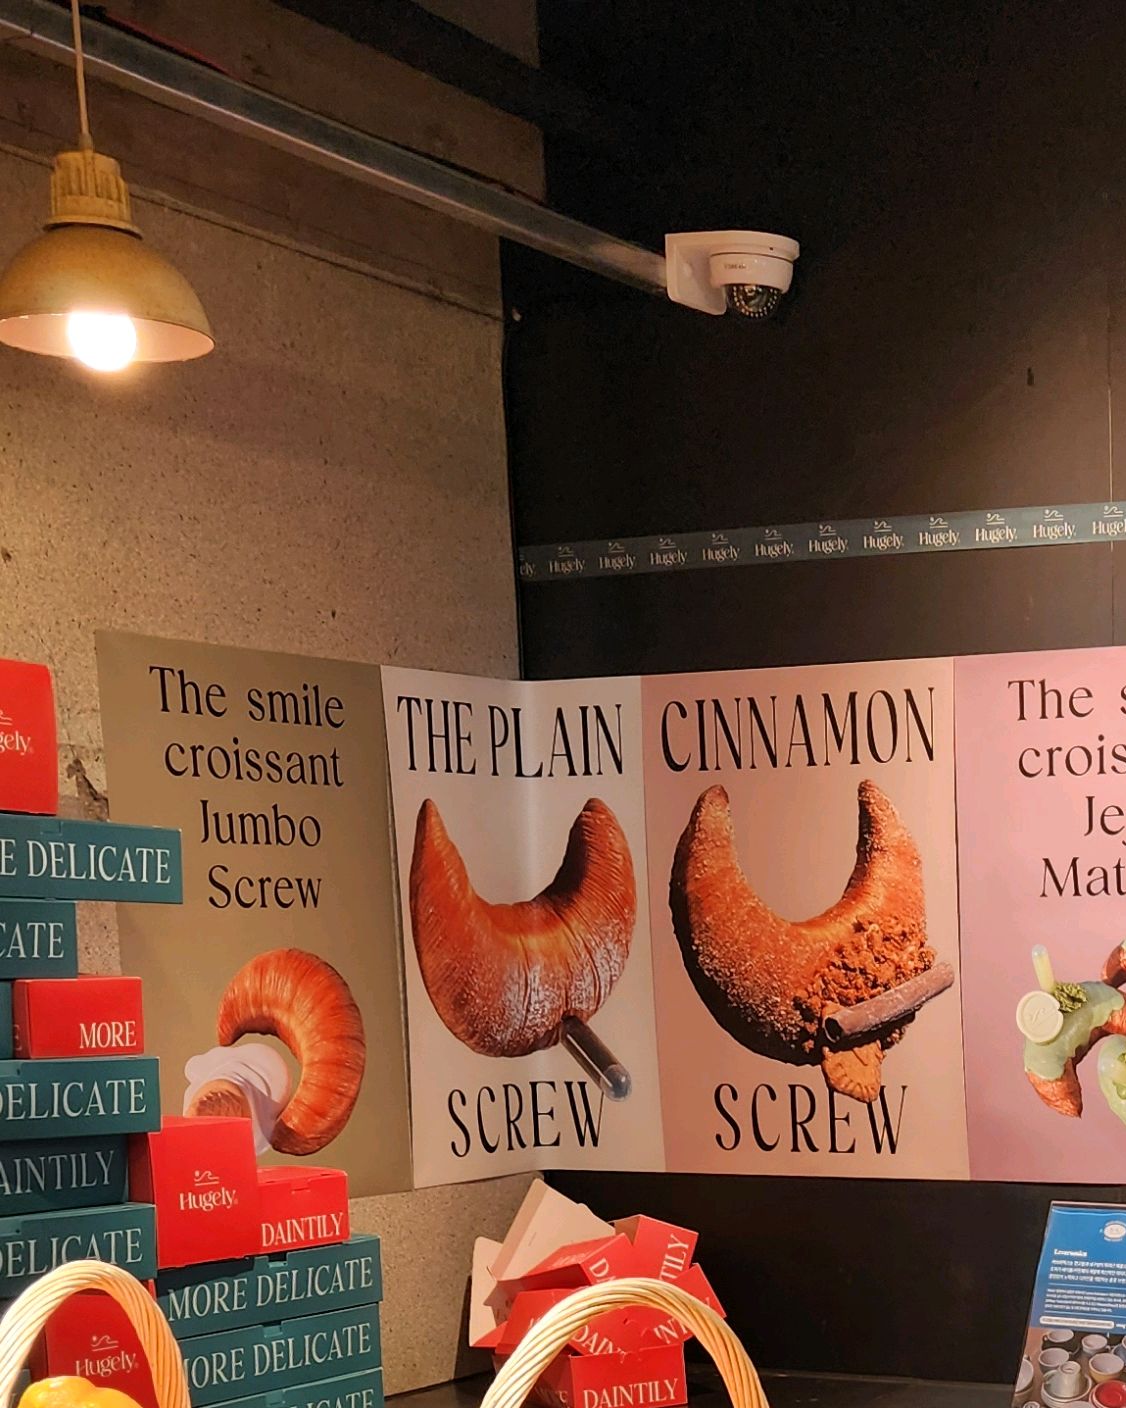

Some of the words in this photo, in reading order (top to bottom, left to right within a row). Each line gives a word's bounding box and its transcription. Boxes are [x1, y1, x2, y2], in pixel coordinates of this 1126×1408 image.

[599, 555, 636, 571] Hugely
[650, 550, 687, 568] Hugely
[702, 546, 740, 562] Hugely
[755, 542, 793, 558] Hugely
[809, 538, 848, 554] Hugely
[863, 534, 903, 550] Hugely
[919, 531, 960, 547] Hugely
[975, 526, 1018, 543] Hugely
[1032, 522, 1075, 540] Hugely
[149, 665, 227, 719] The
[247, 683, 345, 729] smile
[1007, 677, 1094, 721] The
[398, 696, 476, 775] THE
[490, 703, 623, 778] PLAIN
[660, 687, 935, 773] CINNAMON
[165, 738, 345, 787] croissant
[200, 800, 321, 848] Jumbo
[27, 840, 171, 884] DELICATE
[208, 865, 321, 908] Screw
[80, 1021, 136, 1048] MORE
[0, 1079, 146, 1120] ELICATE
[448, 1080, 604, 1157] SCREW
[715, 1082, 907, 1155] SCREW
[0, 1150, 114, 1195] AINTILY
[179, 1187, 237, 1212] Hugely
[0, 1228, 142, 1278] ELICATE
[261, 1212, 343, 1247] DAINTILY
[168, 1278, 248, 1321] MORE
[256, 1257, 373, 1307] DELICATE
[76, 1351, 136, 1377] Hugely
[254, 1323, 371, 1377] DELICATE
